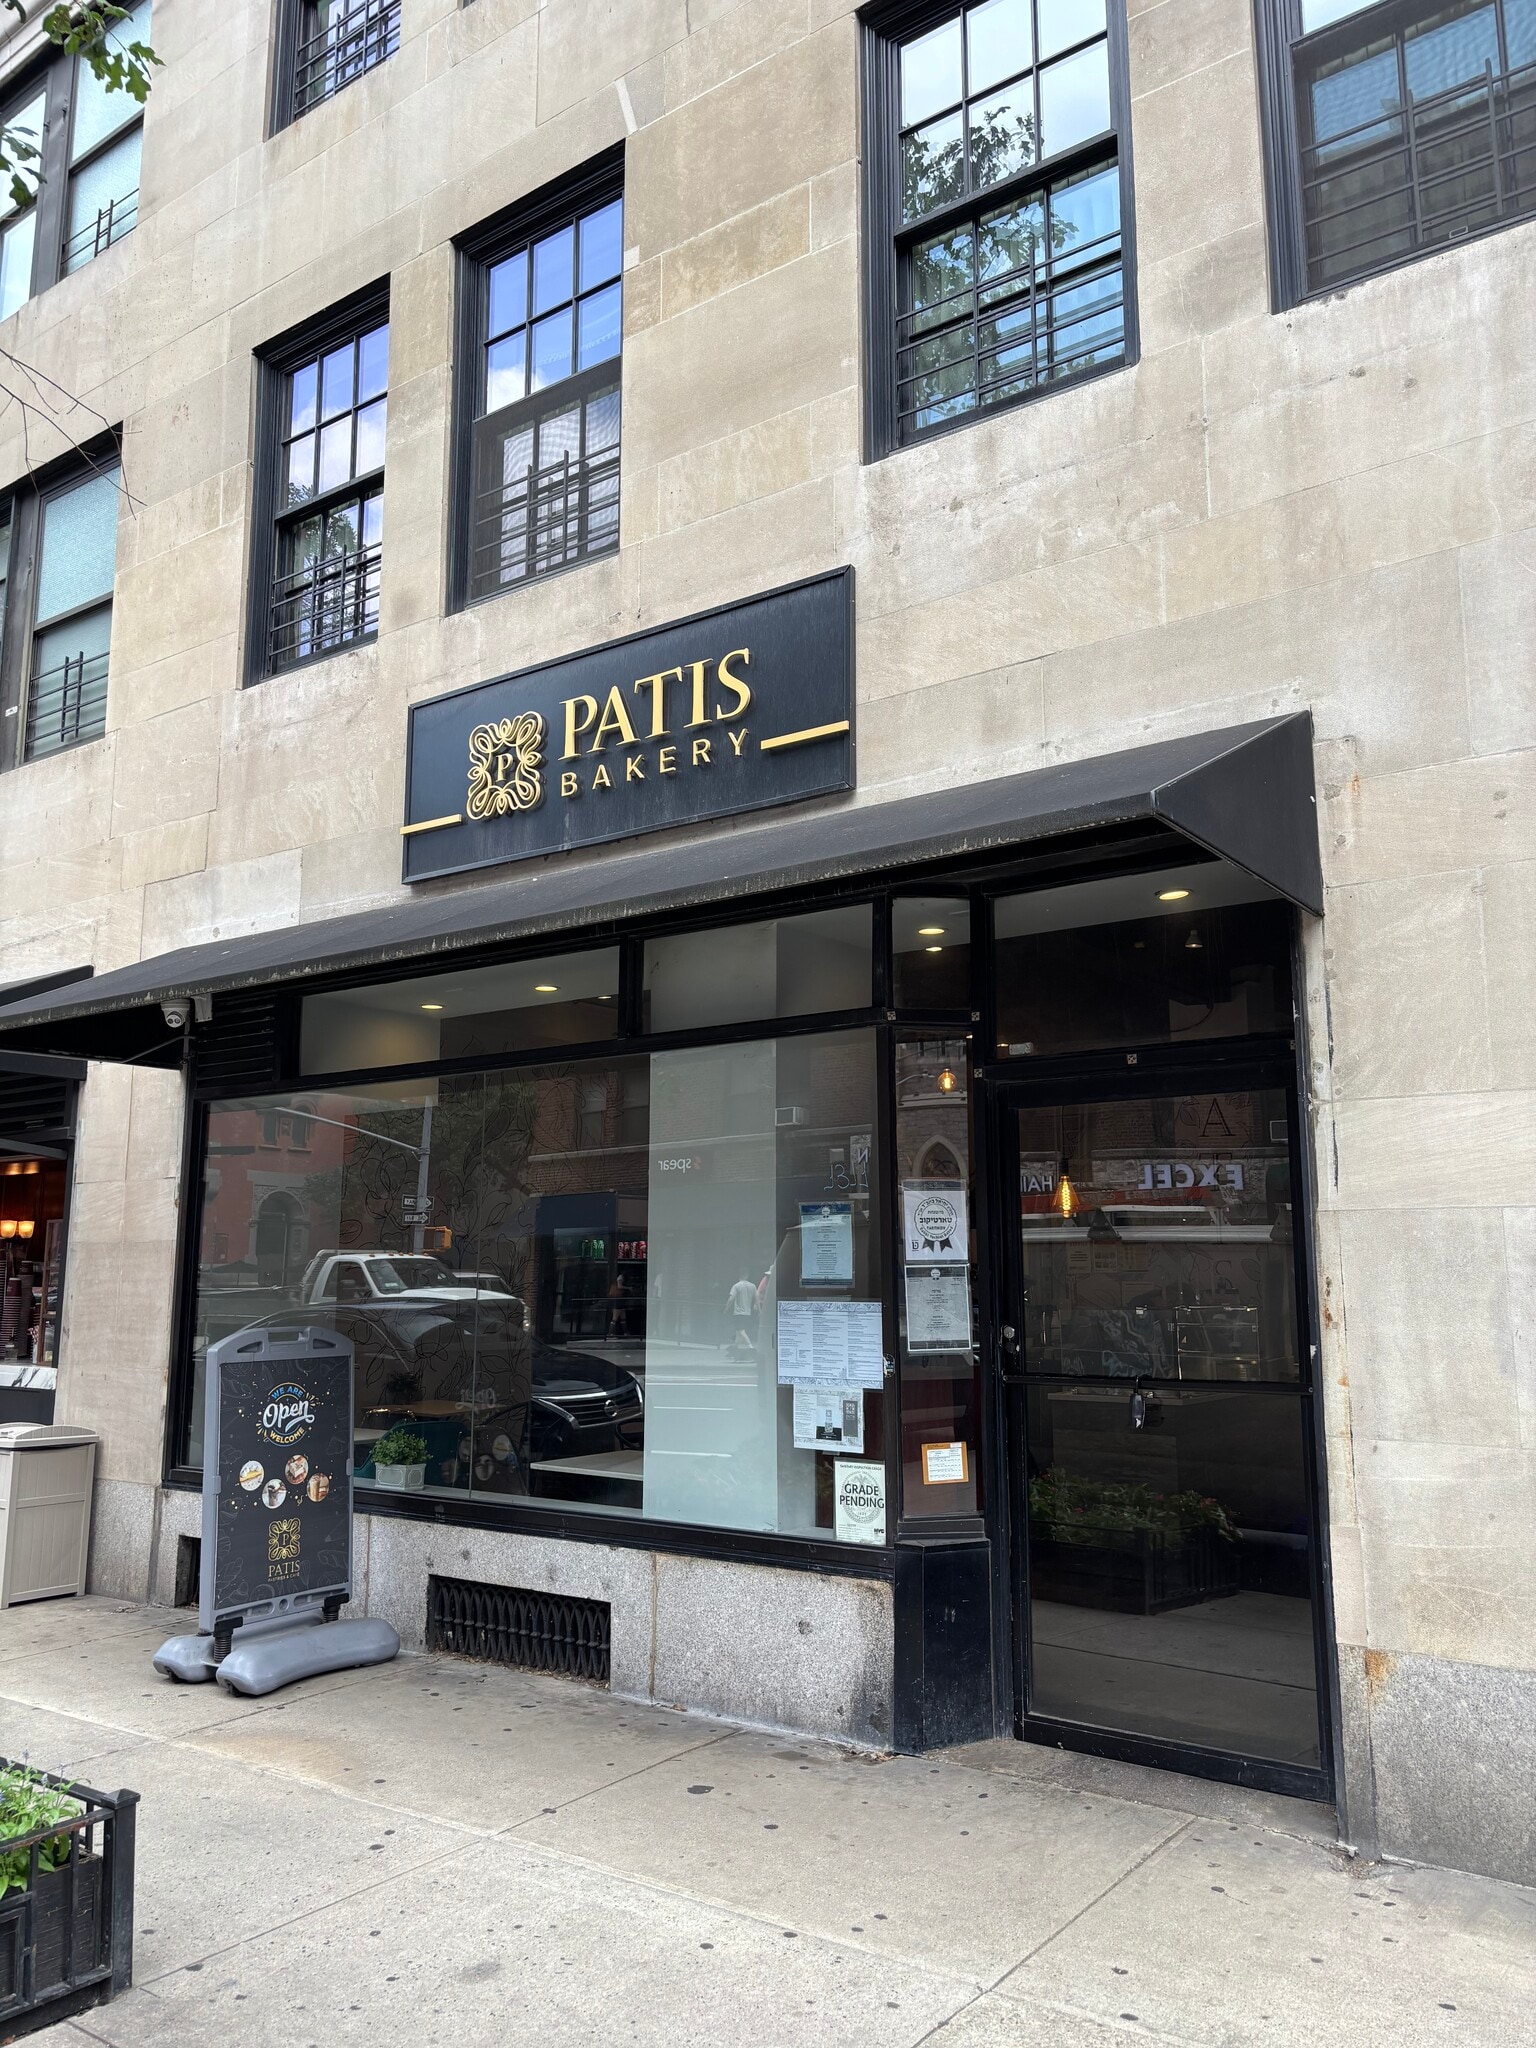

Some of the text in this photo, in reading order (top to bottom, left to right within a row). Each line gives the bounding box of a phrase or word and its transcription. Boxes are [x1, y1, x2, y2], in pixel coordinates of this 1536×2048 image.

[558, 648, 751, 761] PATIS
[496, 753, 514, 782] P
[561, 728, 749, 798] BAKERY
[271, 1386, 304, 1399] WE ARE
[263, 1400, 315, 1432] Open
[270, 1427, 305, 1444] WELCOME
[844, 1483, 879, 1496] GRADE
[839, 1495, 885, 1509] PENDING
[268, 1560, 300, 1578] PATIS
